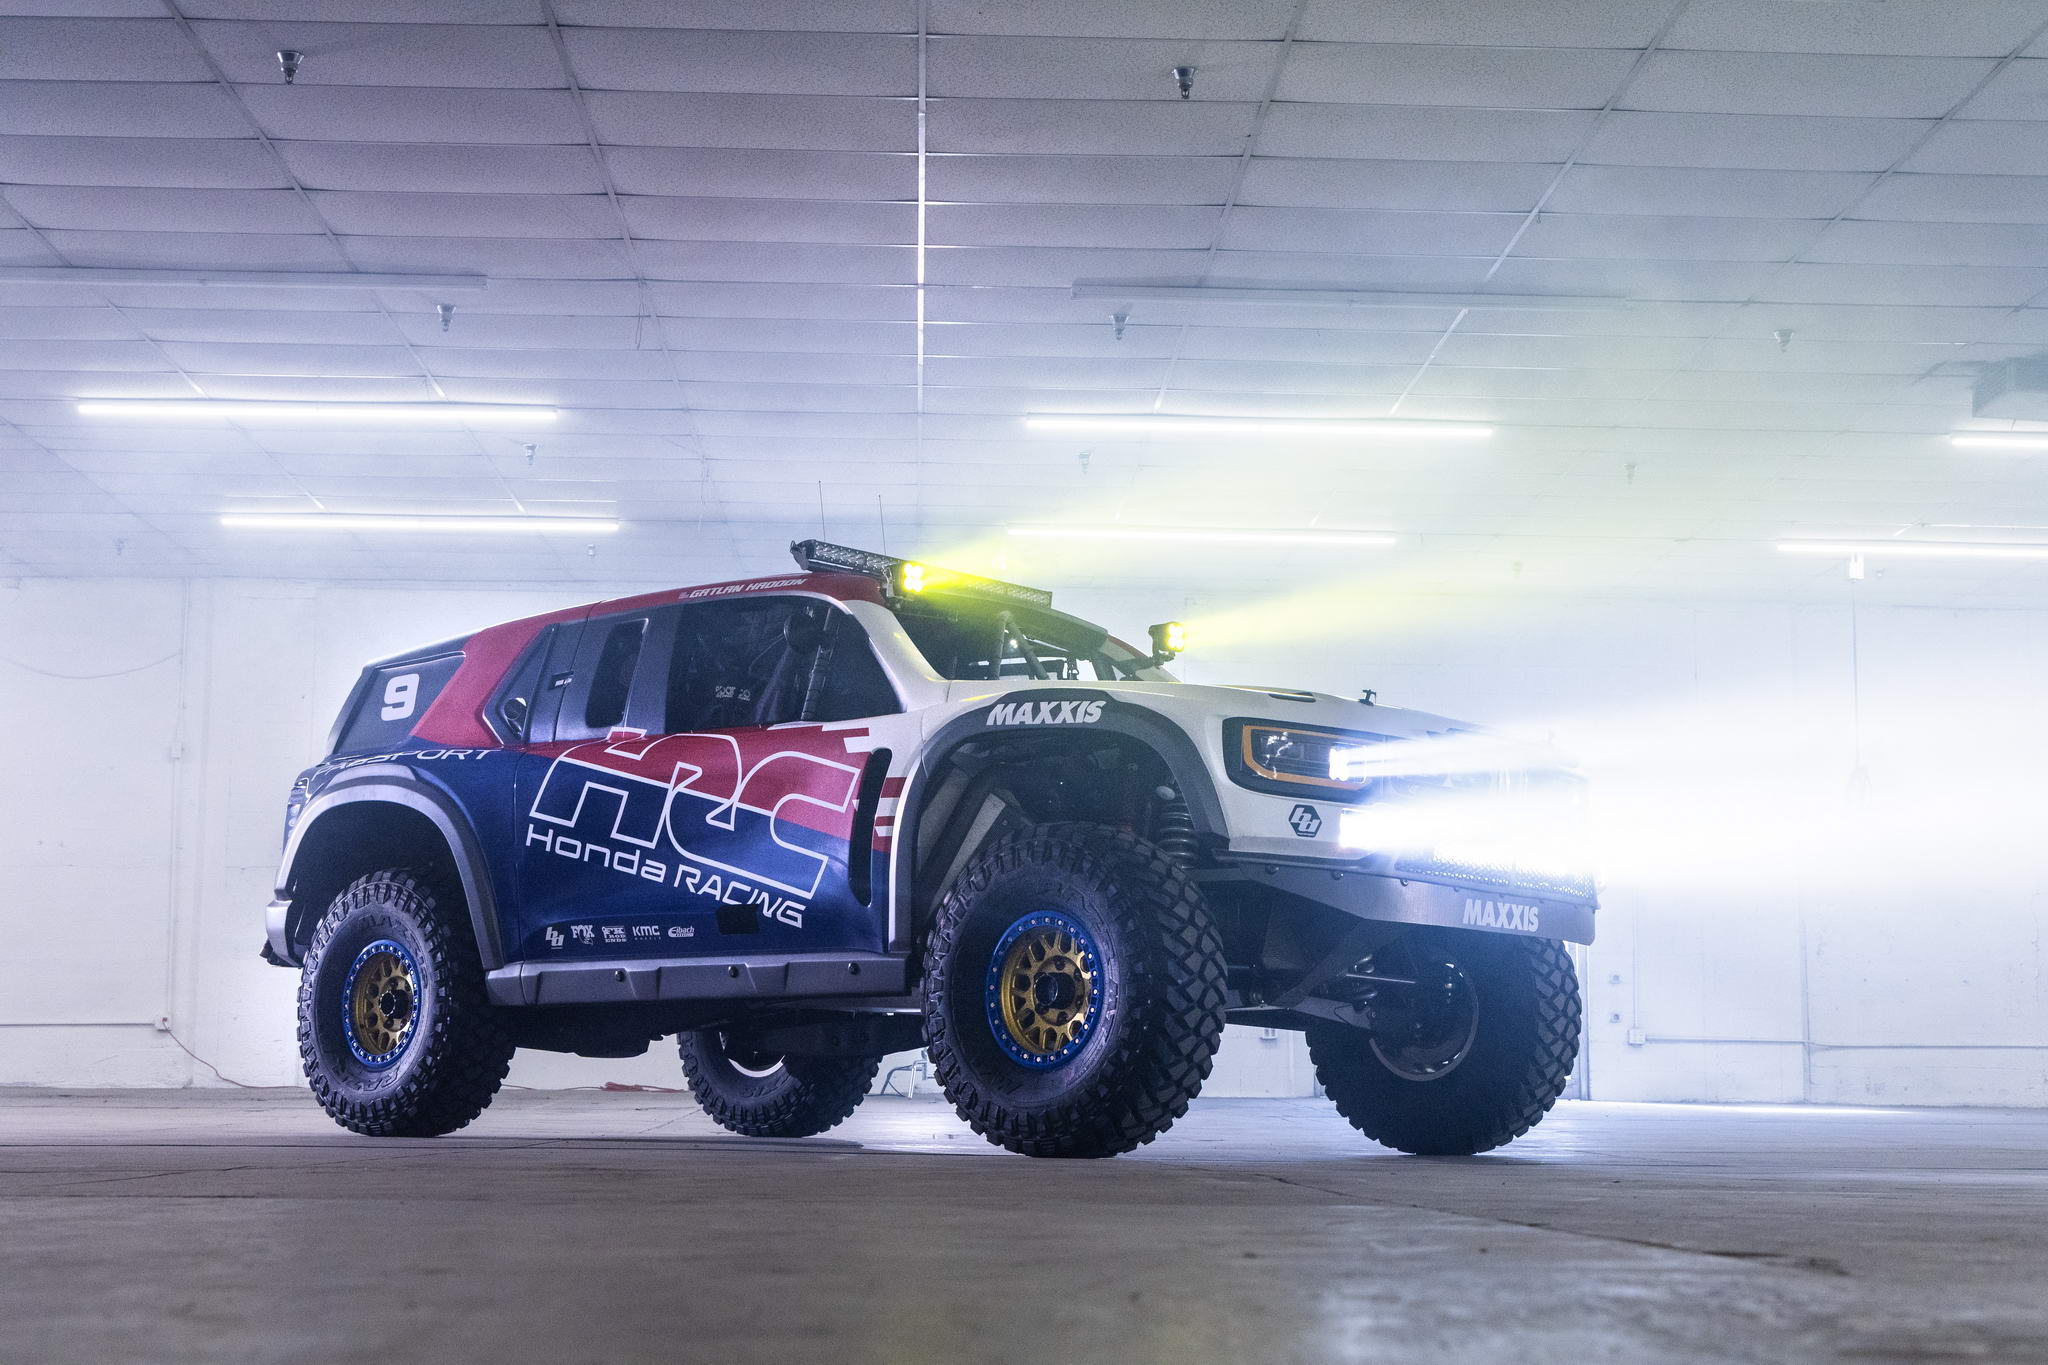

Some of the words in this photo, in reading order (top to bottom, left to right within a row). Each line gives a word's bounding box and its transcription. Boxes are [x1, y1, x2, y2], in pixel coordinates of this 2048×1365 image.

[380, 673, 420, 721] 9
[985, 700, 1107, 726] MAXXIS
[526, 824, 666, 883] Honda
[673, 864, 808, 929] RACING
[1462, 898, 1539, 933] MAXXIS
[570, 924, 595, 940] FOX
[632, 925, 660, 937] KMC
[667, 925, 695, 938] Eibach
